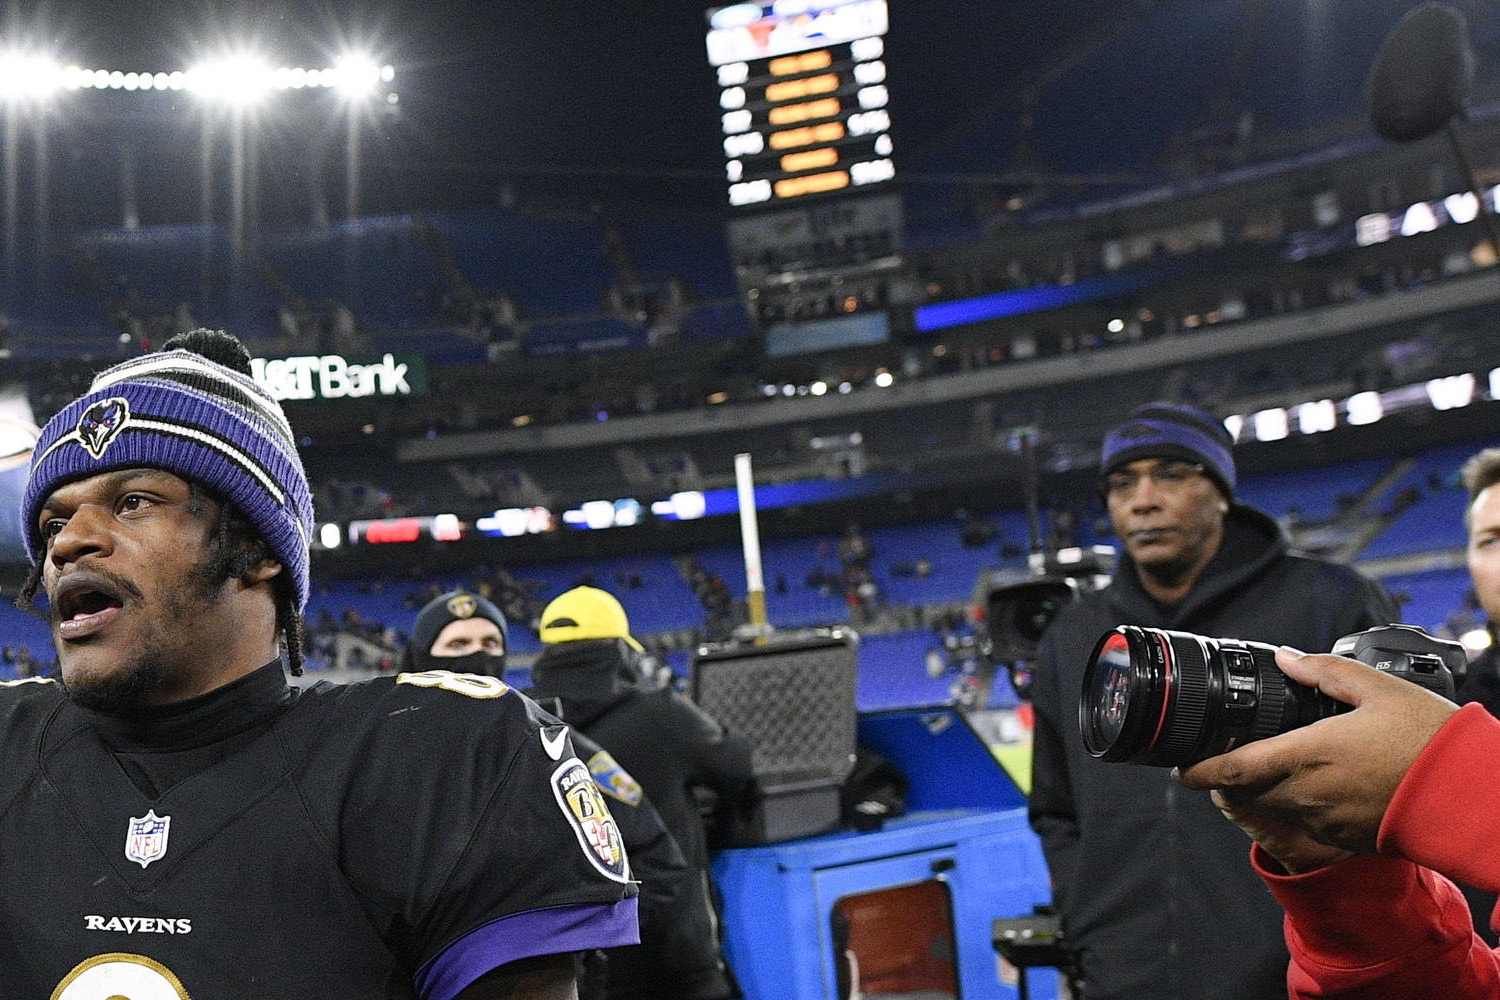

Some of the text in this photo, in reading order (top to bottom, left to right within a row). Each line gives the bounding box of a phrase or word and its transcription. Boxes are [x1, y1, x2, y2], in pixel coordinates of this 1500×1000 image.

[319, 353, 411, 398] Bank
[132, 836, 160, 857] NFL
[84, 915, 192, 935] RAVENS
